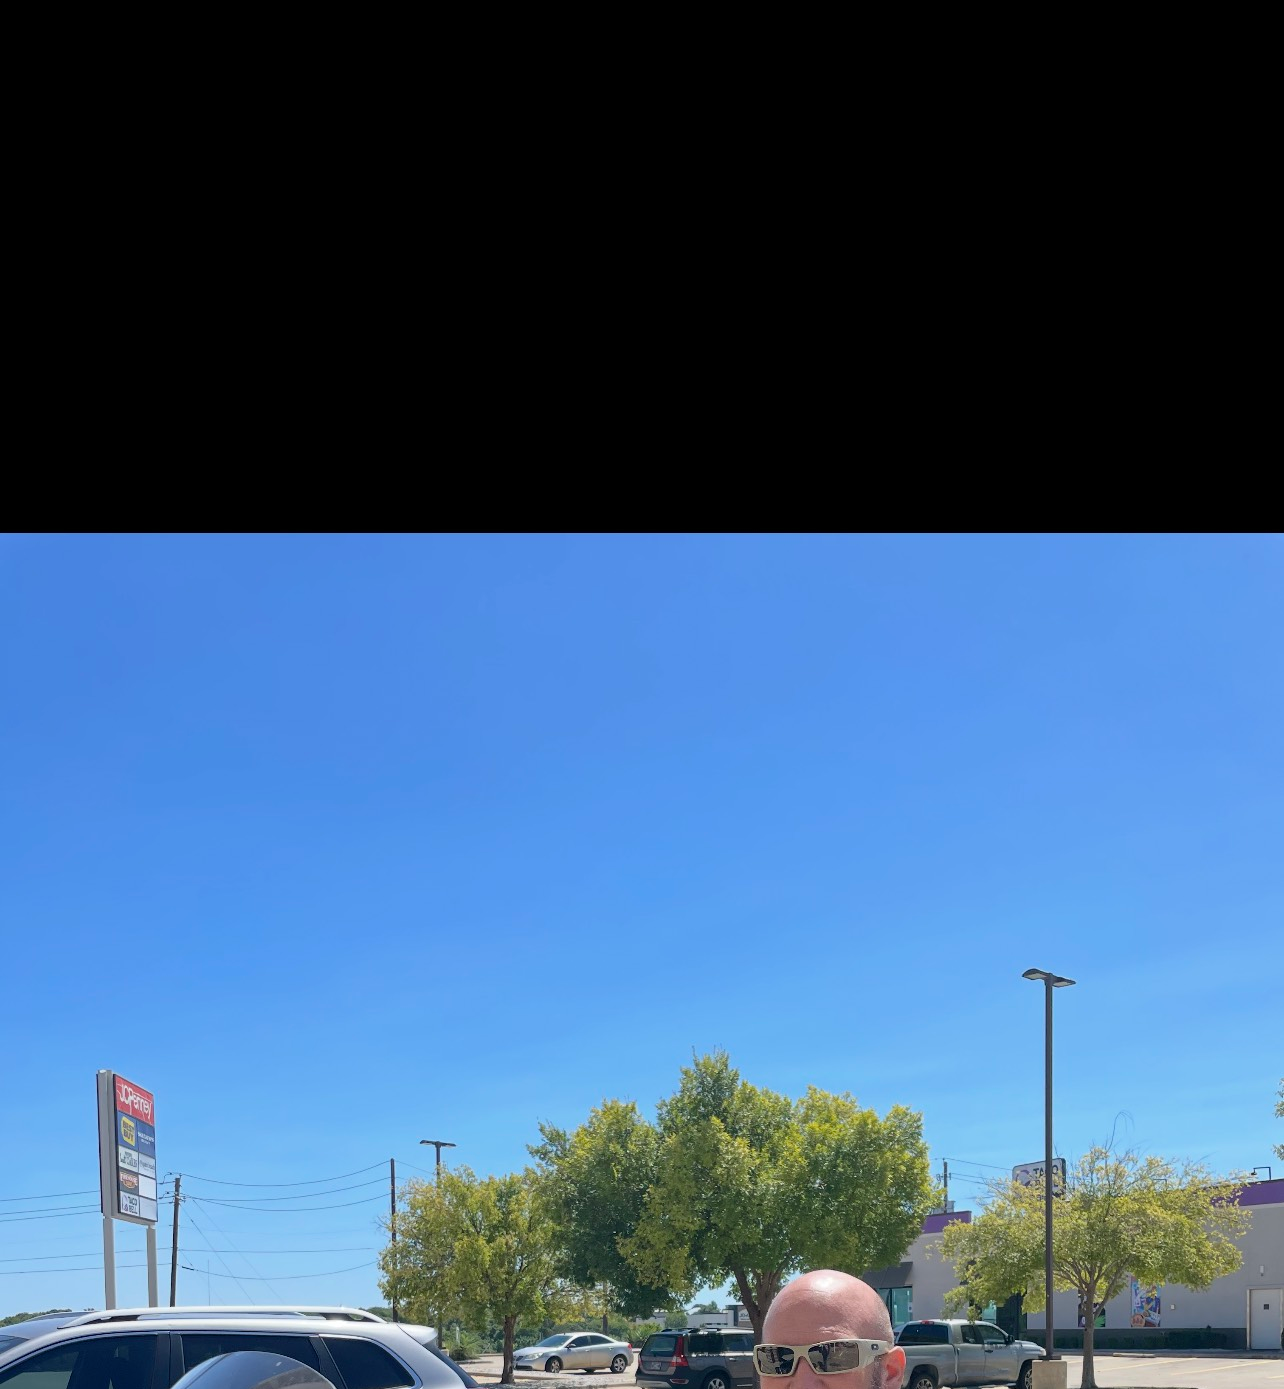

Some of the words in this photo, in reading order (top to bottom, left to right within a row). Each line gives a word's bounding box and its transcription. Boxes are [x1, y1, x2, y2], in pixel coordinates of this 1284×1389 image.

[123, 1120, 134, 1133] BEST
[123, 1130, 134, 1142] BUY
[1033, 1165, 1058, 1176] TAO
